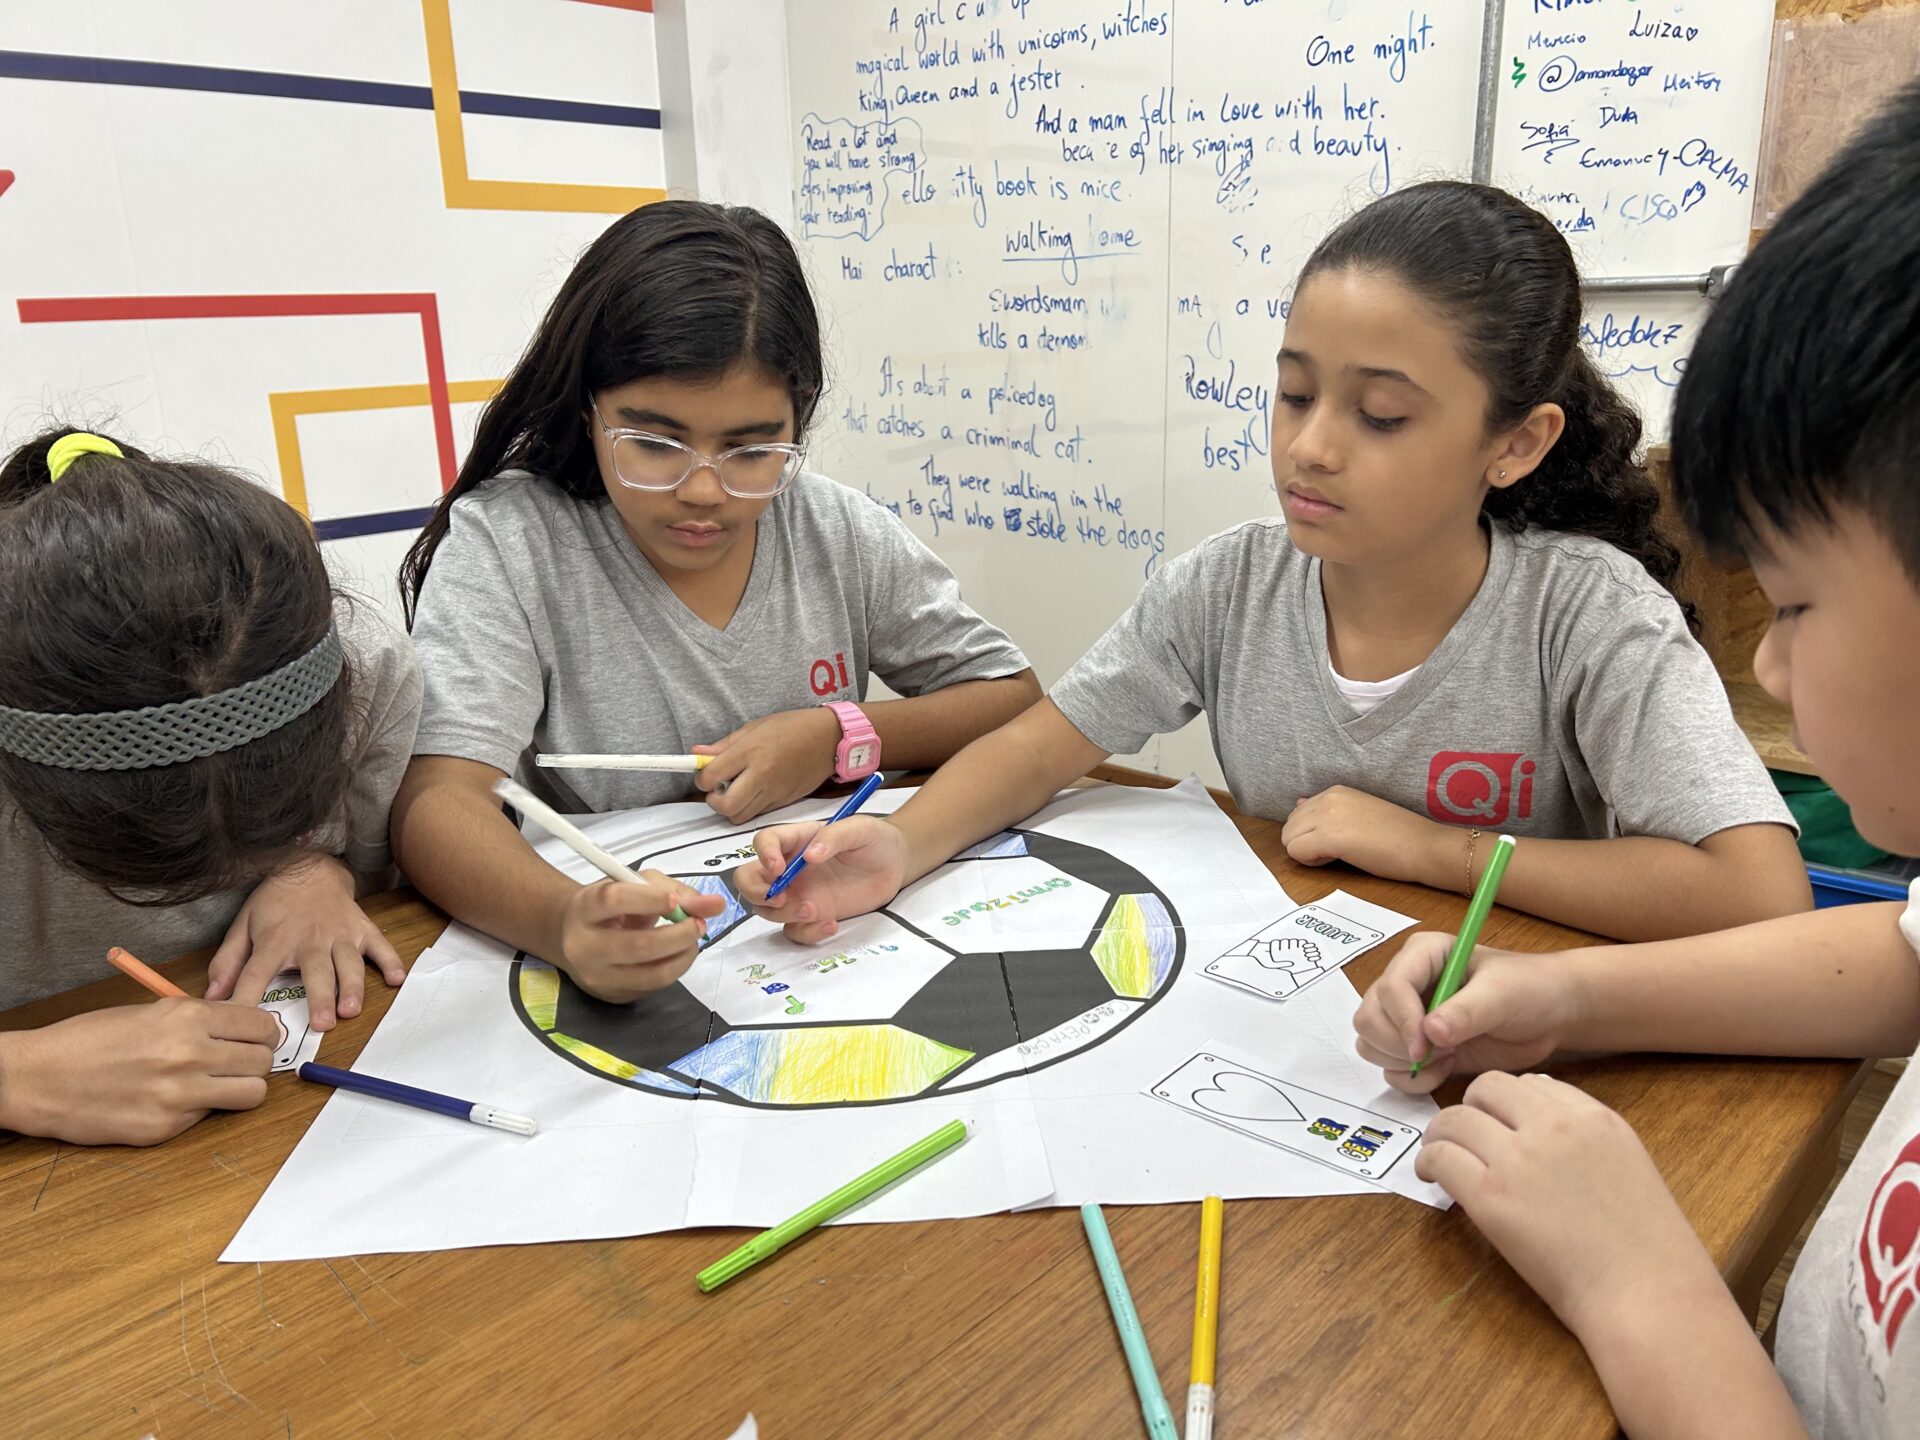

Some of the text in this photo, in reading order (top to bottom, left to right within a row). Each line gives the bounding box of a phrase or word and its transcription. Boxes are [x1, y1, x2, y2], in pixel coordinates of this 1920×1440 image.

[888, 8, 901, 34] A
[914, 0, 945, 53] girl
[1306, 10, 1435, 83] One night.
[1629, 10, 1684, 40] Luiza
[856, 46, 910, 100] magical
[918, 37, 960, 69] world
[971, 28, 1005, 64] with
[1102, 0, 1168, 41] witches
[895, 84, 941, 106] Queen
[949, 77, 979, 100] and
[989, 82, 999, 95] a
[1005, 59, 1063, 119] jester
[801, 123, 832, 151] Read
[839, 136, 848, 148] a
[876, 129, 898, 148] and
[1035, 103, 1062, 135] And
[1068, 119, 1078, 132] a
[1088, 113, 1128, 131] man
[1140, 86, 1176, 147] fell
[1186, 99, 1206, 123] in
[1275, 84, 1322, 120] with
[803, 146, 916, 186] you will have strong
[1129, 134, 1147, 174] of
[1159, 131, 1185, 165] her
[1192, 131, 1254, 177] singing
[994, 159, 1038, 197] book
[1049, 176, 1069, 200] is
[1236, 298, 1250, 315] a
[1017, 333, 1029, 349] a
[960, 387, 972, 400] a
[1183, 354, 1269, 456] Rowley
[941, 425, 954, 442] a
[966, 422, 1041, 459] criminal
[1203, 426, 1251, 472] best
[920, 454, 952, 507] They
[958, 473, 992, 495] were
[1070, 489, 1089, 510] in
[1093, 483, 1124, 517] the
[906, 488, 924, 516] to
[928, 498, 956, 537] find
[964, 500, 996, 530] who
[1026, 507, 1068, 543] stole
[1076, 515, 1112, 548] the
[809, 652, 850, 697] Qi
[1294, 913, 1362, 945] AJUDAR
